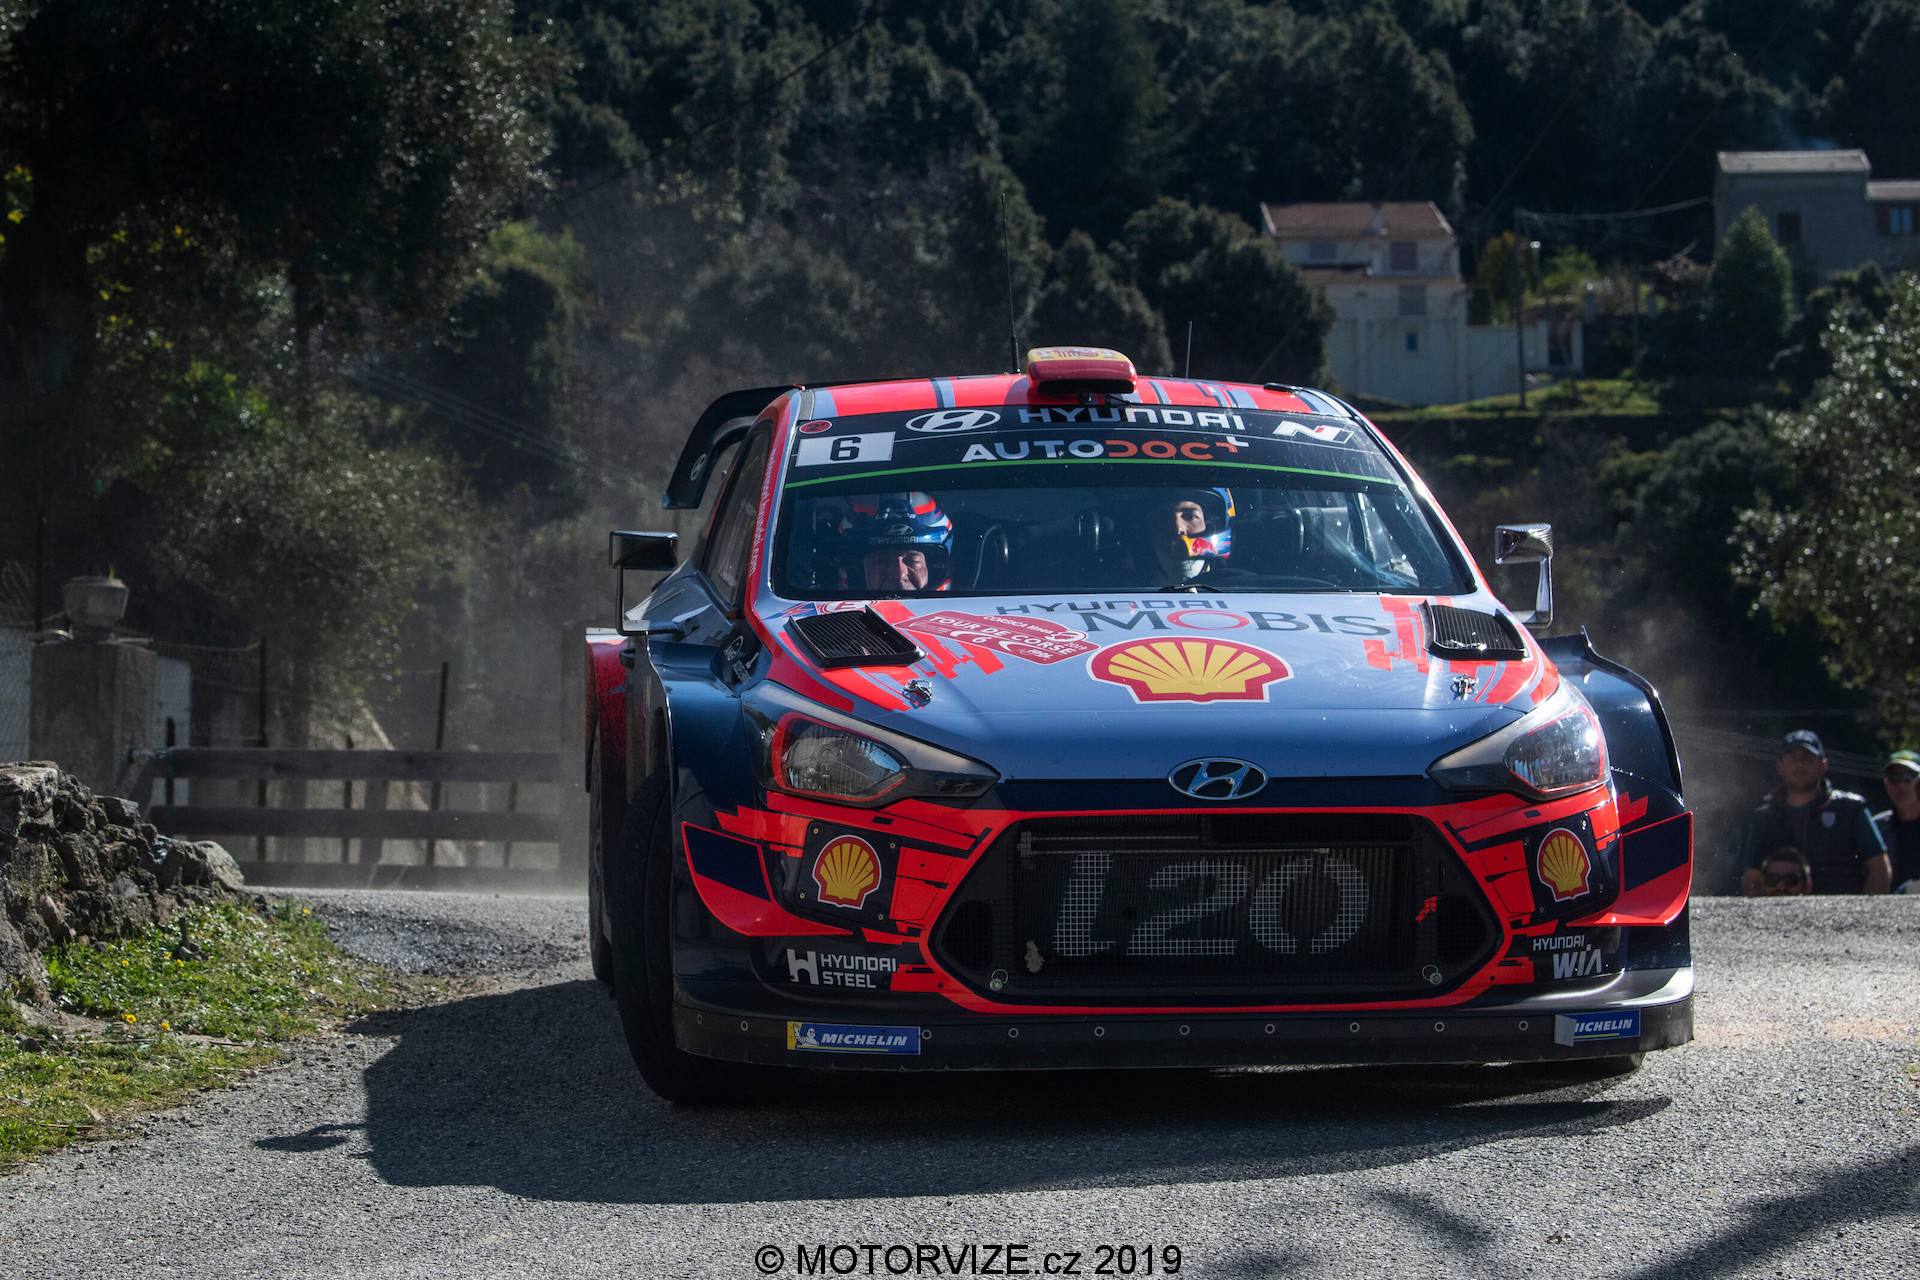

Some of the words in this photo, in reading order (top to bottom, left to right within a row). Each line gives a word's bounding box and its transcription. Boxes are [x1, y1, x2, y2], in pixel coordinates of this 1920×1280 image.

[1018, 407, 1246, 430] HYUNDAI
[829, 436, 862, 462] 6
[878, 535, 919, 544] HYUNDAI
[996, 600, 1229, 615] HYUNDAI
[1077, 608, 1392, 636] MOBIS
[929, 615, 976, 631] TOUR
[980, 627, 1012, 638] DE
[1010, 634, 1078, 656] CORSE
[972, 636, 993, 644] 6
[1533, 935, 1585, 951] HYUNDAI
[820, 953, 898, 972] HYUNDAI
[1553, 944, 1602, 980] WIA
[822, 972, 877, 989] STEEL
[821, 1033, 908, 1047] MICHELIN
